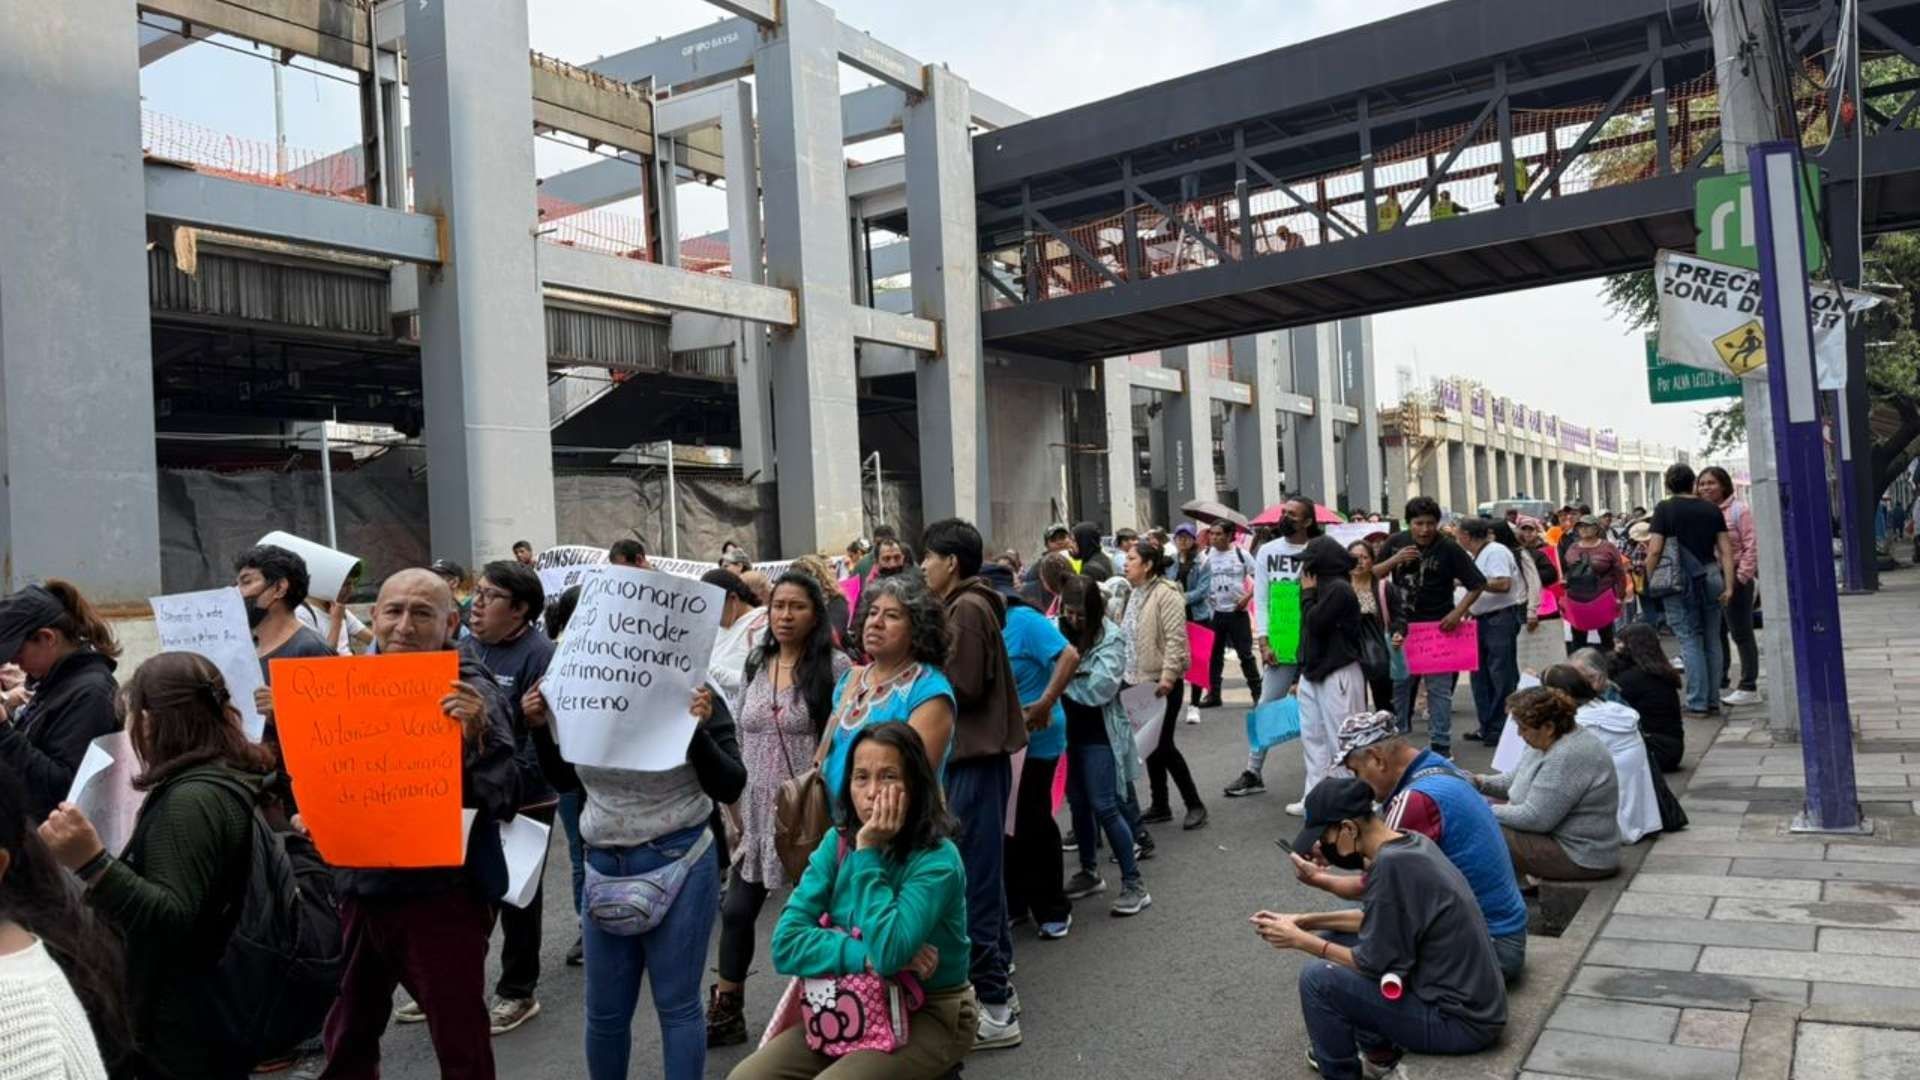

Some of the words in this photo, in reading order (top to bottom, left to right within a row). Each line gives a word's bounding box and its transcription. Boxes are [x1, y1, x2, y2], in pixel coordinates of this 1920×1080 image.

[1664, 277, 1728, 309] ZONA
[536, 548, 602, 571] CONSULTA
[557, 686, 629, 712] terreno
